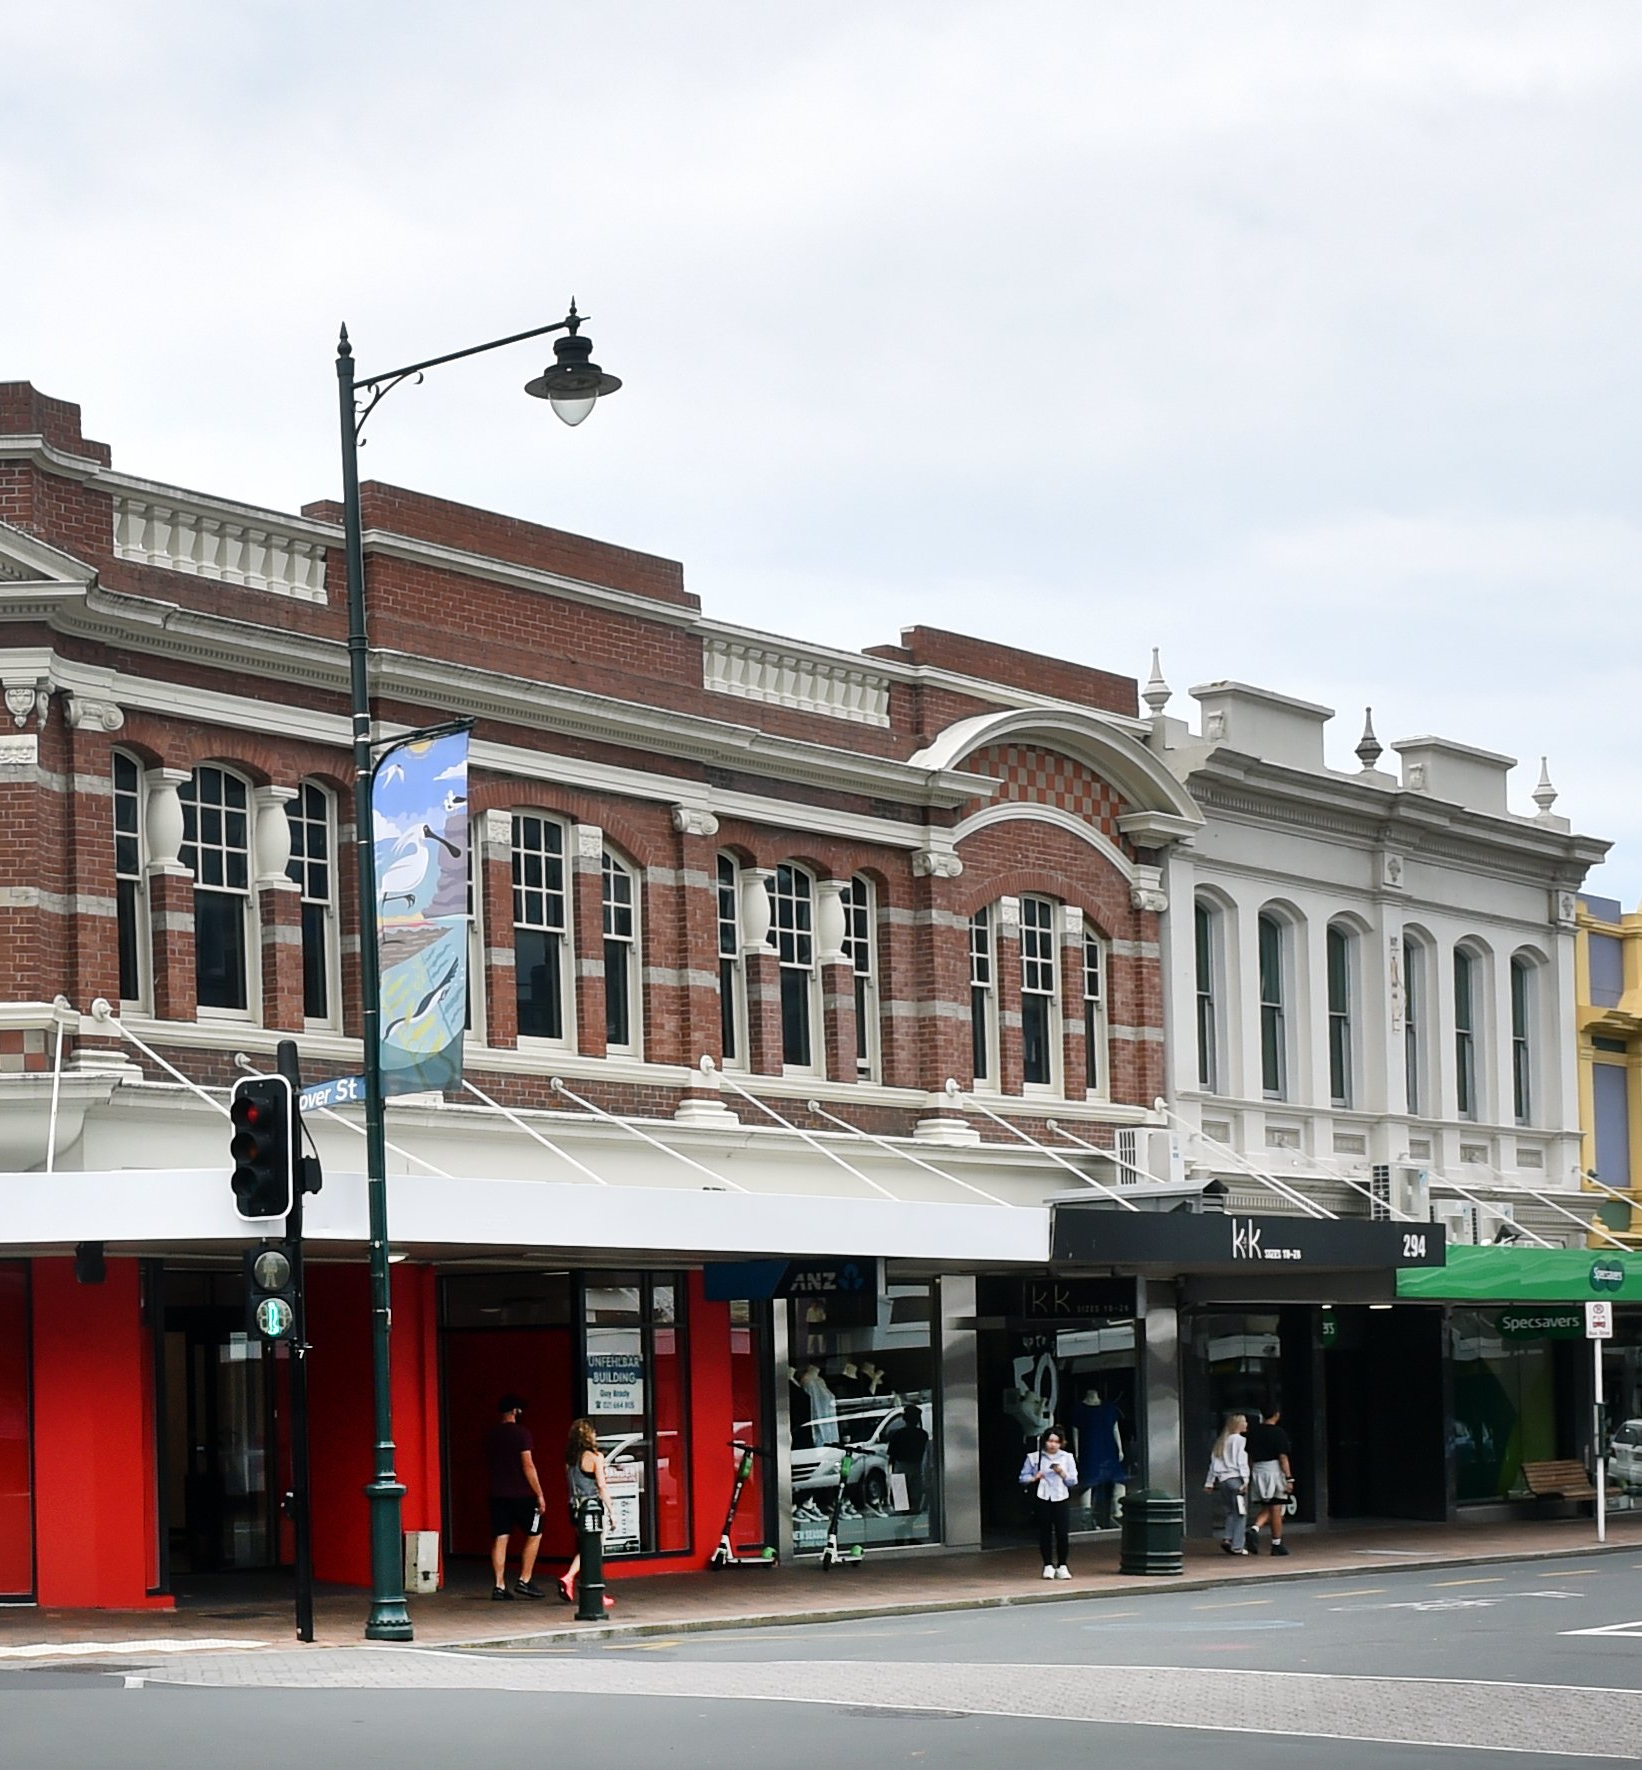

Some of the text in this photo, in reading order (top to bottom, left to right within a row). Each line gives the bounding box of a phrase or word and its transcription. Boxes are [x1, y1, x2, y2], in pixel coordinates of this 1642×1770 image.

[299, 1078, 358, 1111] over St
[1403, 1234, 1426, 1258] 294
[790, 1272, 837, 1291] ANZ
[1502, 1316, 1580, 1333] Specsavers
[298, 1349, 305, 1359] 7
[588, 1355, 640, 1368] UNFEHLBAR
[593, 1371, 636, 1384] BUILDING
